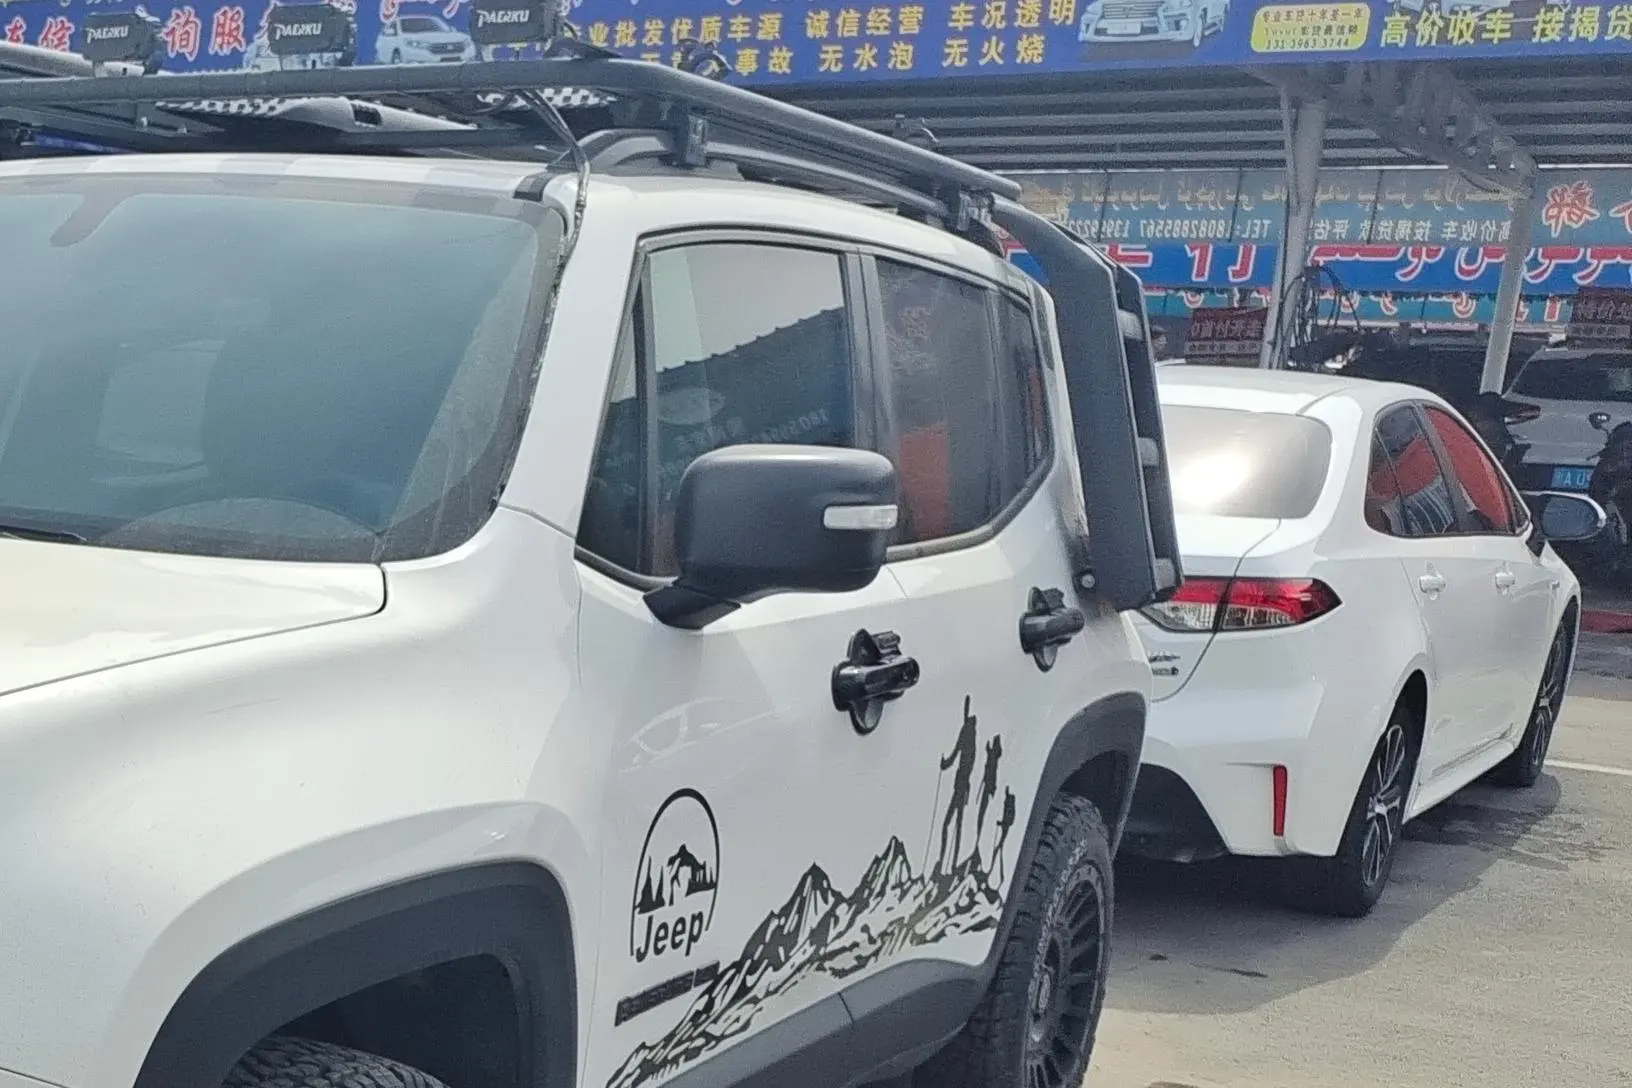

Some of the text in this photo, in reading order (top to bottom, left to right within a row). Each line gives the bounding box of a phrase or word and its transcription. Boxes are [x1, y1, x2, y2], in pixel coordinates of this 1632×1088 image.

[805, 5, 924, 39] 诚信经营
[948, 0, 1076, 31] 车况透明
[1380, 8, 1514, 48] 高价收车
[819, 41, 915, 73] 无水泡
[942, 33, 1046, 68] 无火烧
[635, 910, 705, 963] Jeep
